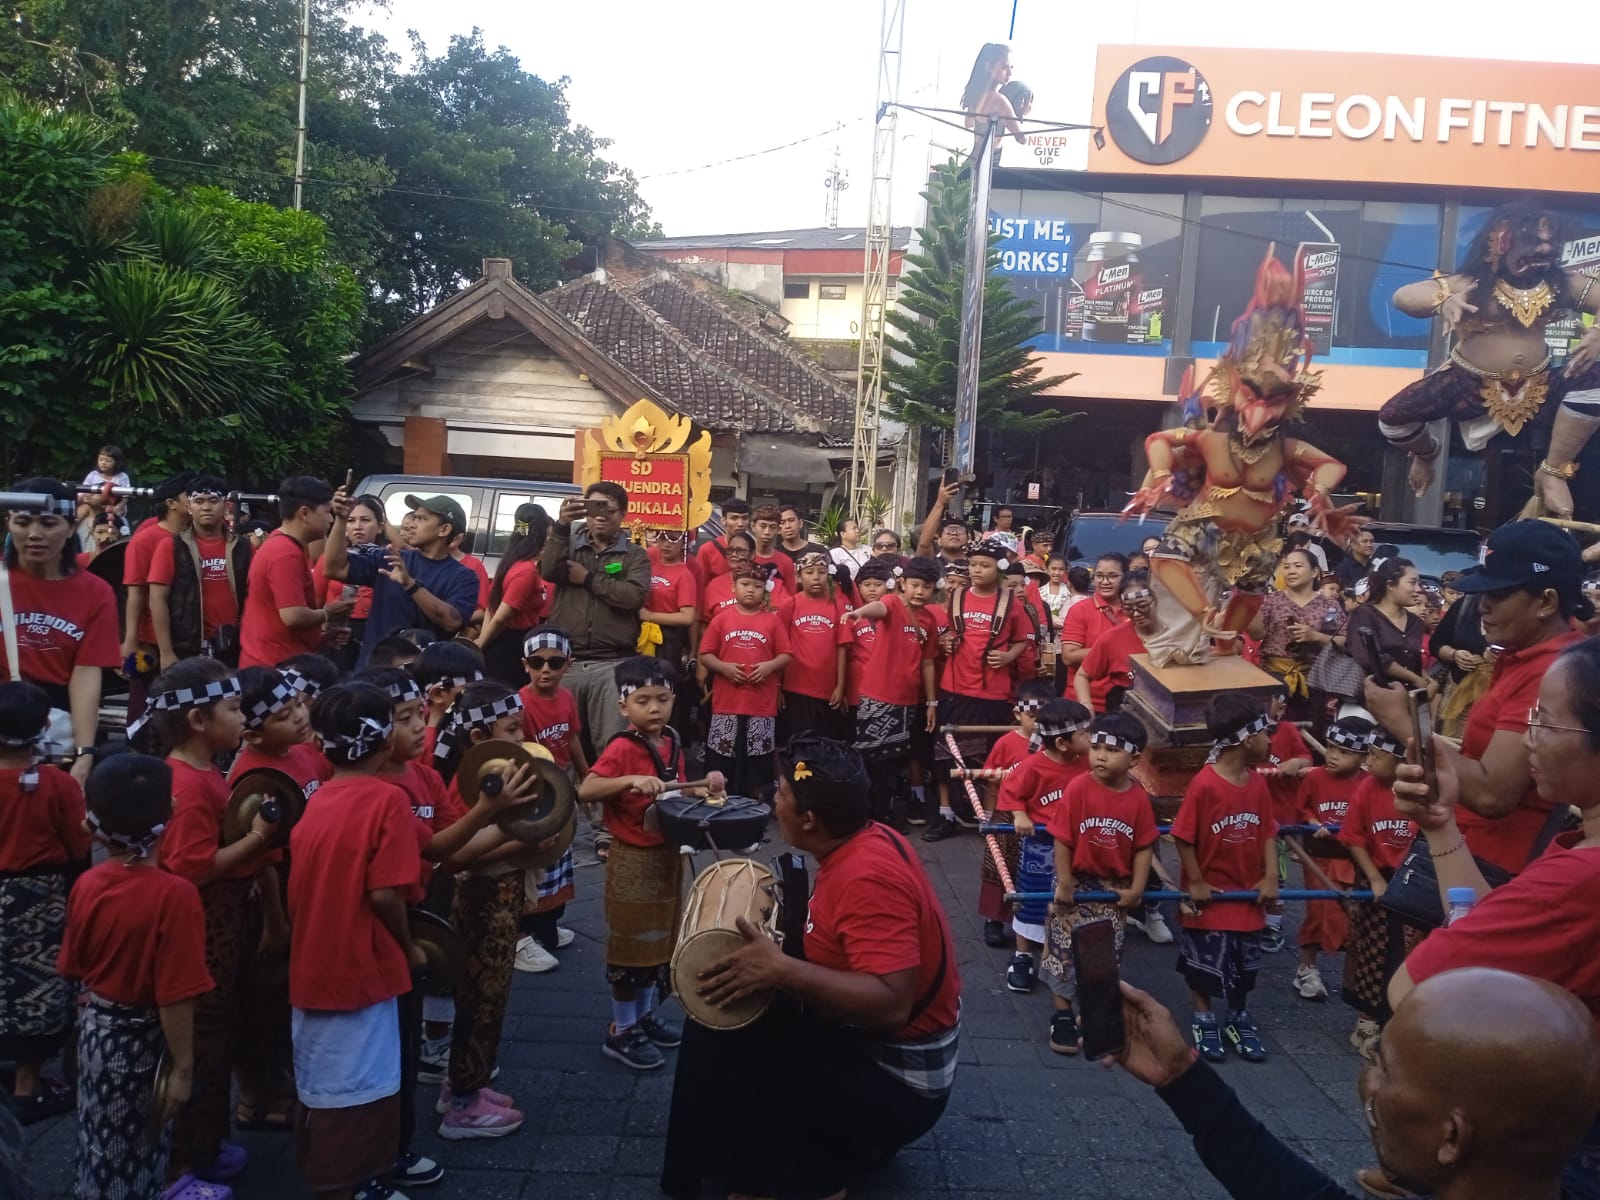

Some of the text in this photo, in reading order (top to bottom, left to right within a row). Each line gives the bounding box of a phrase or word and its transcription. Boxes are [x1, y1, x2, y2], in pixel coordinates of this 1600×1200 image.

[1224, 90, 1600, 151] CLEON FITNE
[1028, 136, 1067, 147] NEVER
[1034, 147, 1060, 156] GIVE
[1040, 157, 1053, 165] UP
[1033, 219, 1071, 245] ME,
[1099, 267, 1129, 284] L-Men
[631, 461, 652, 475] SD
[628, 501, 682, 515] DIKALA
[26, 624, 49, 635] 1953
